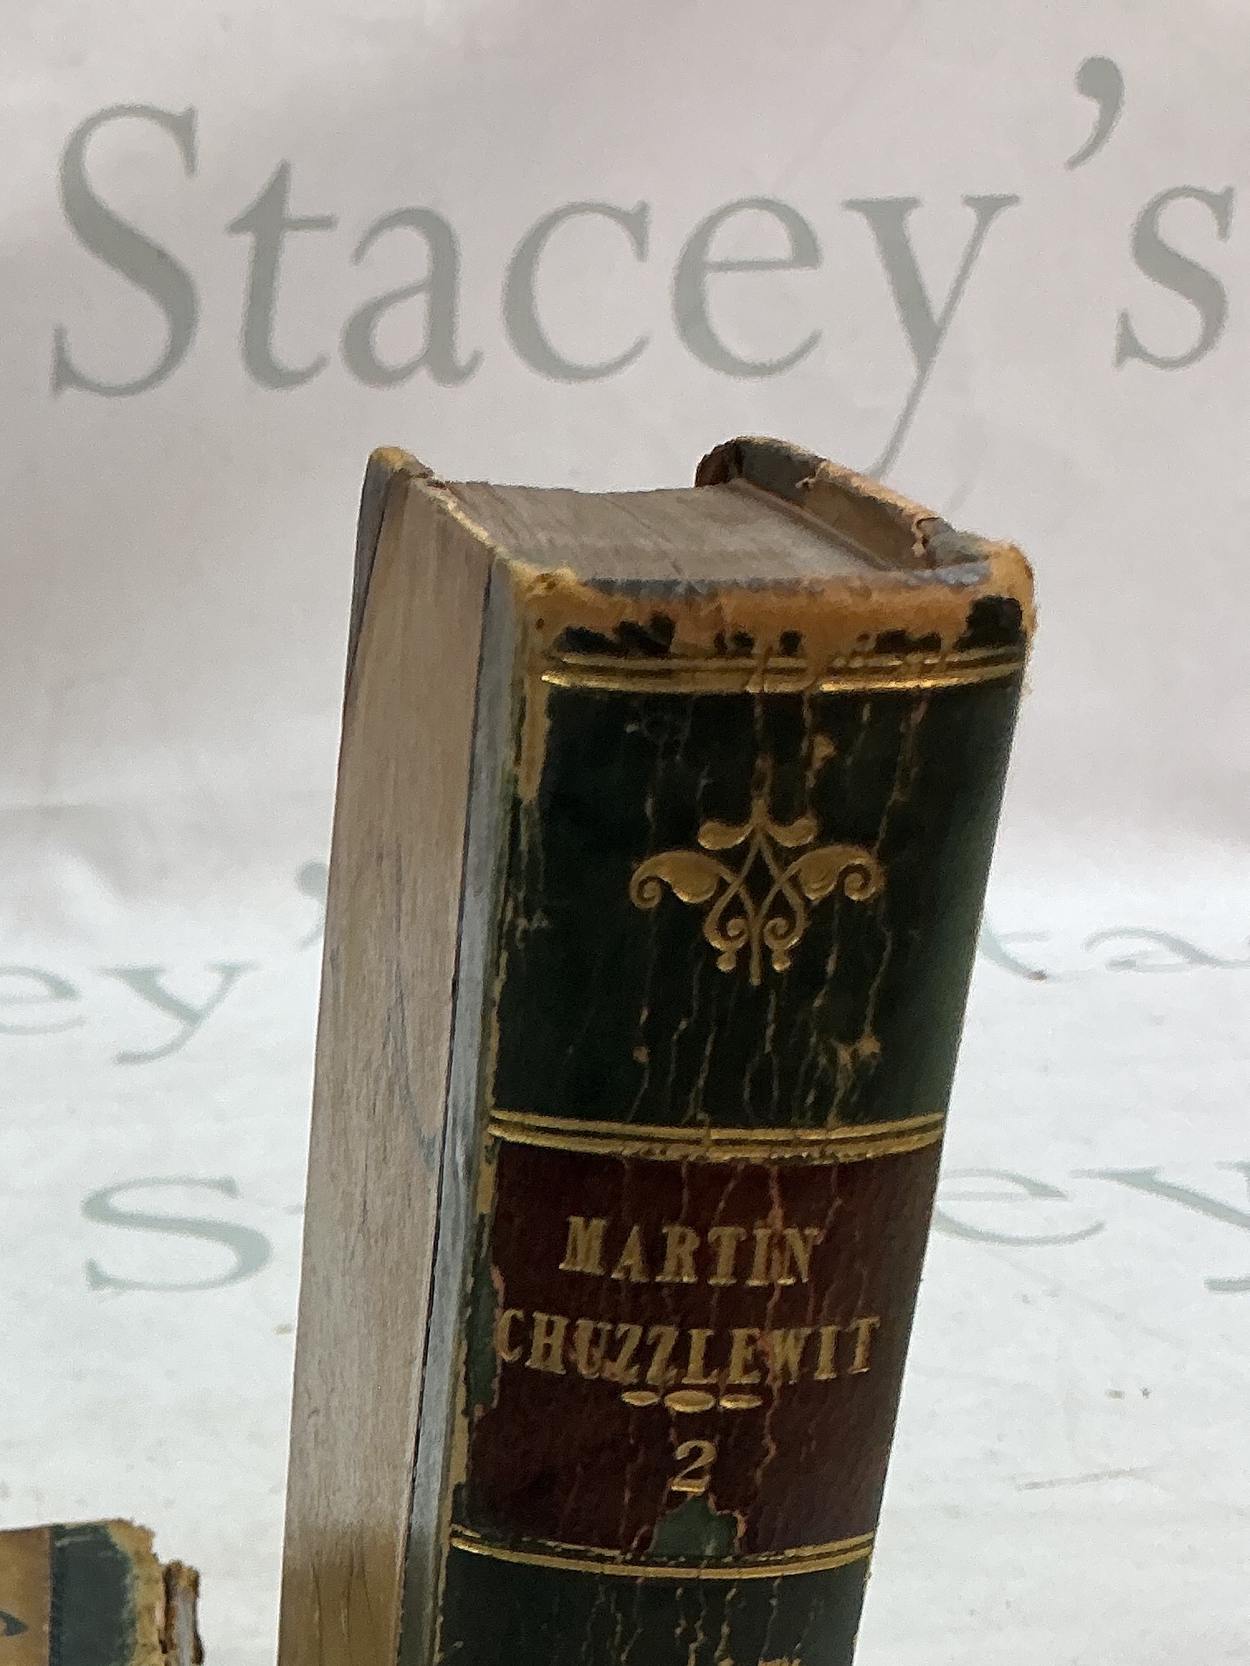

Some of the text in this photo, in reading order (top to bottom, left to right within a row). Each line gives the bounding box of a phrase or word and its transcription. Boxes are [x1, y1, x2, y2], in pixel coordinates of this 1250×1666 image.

[49, 56, 1237, 484] Stacey's
[558, 1214, 821, 1287] MARTIN
[496, 1307, 881, 1385] CHUZZLEWIT
[669, 1438, 718, 1493] 2
